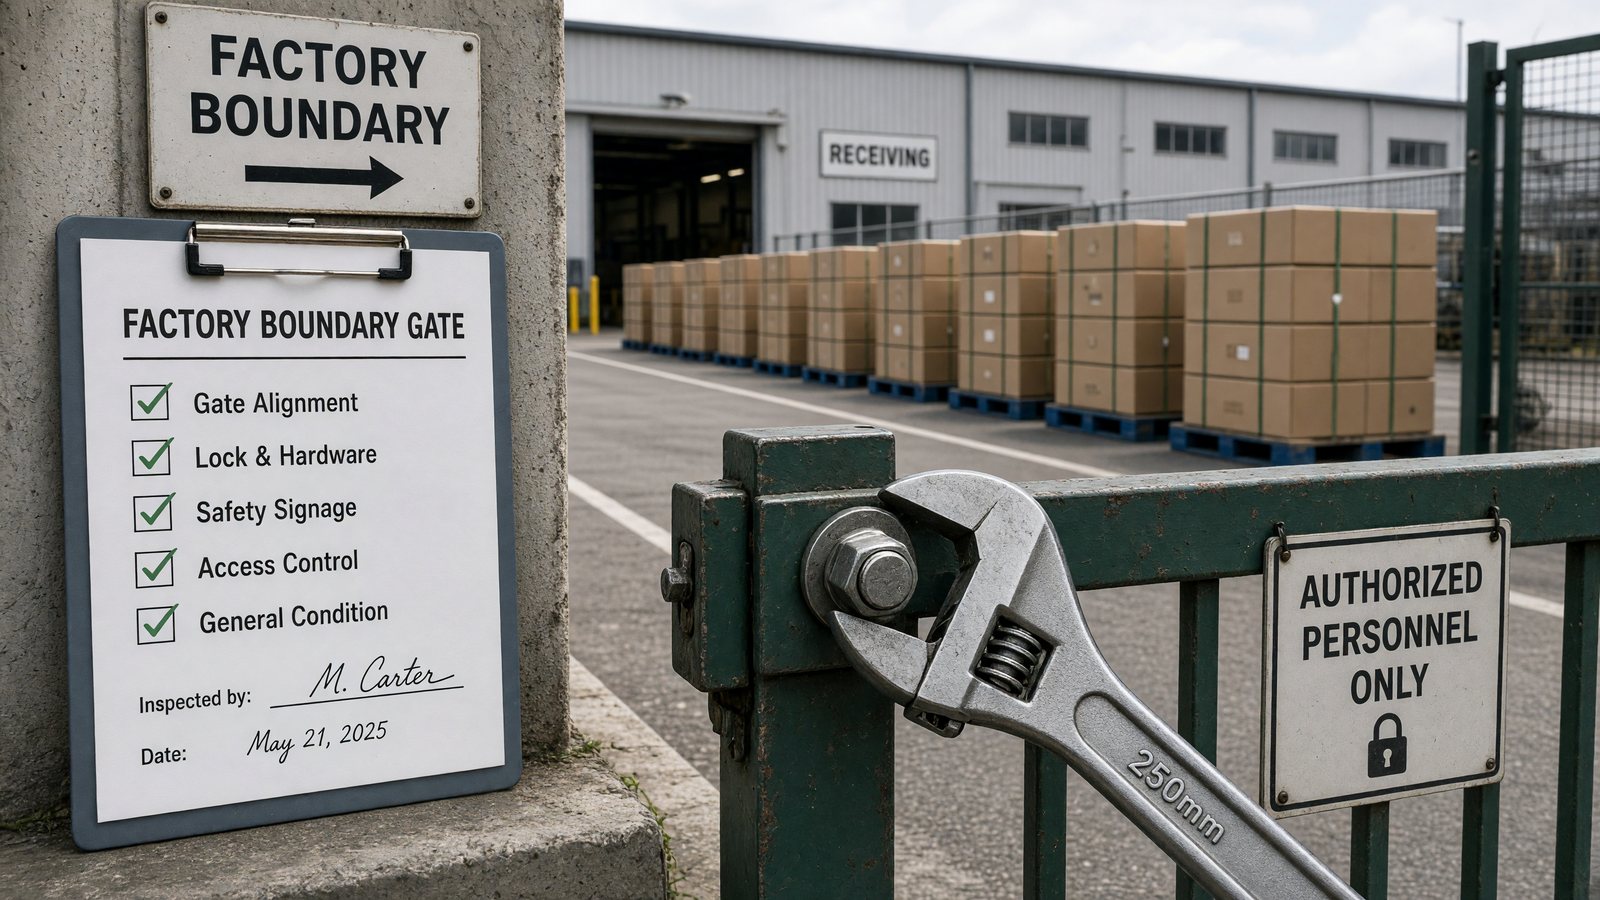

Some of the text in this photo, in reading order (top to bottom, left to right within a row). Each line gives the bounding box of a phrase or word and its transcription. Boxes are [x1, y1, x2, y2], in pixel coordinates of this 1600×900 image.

[210, 33, 427, 89] FACTORY
[190, 91, 450, 146] BOUNDARY
[829, 143, 930, 168] RECEIVING
[123, 308, 465, 340] FACTORY BOUNDARY GATE
[193, 391, 359, 419] Gate Alignment
[195, 444, 377, 469] Lock & Hardware
[196, 498, 357, 527] Safety Signage
[197, 549, 358, 579] Access Control
[1299, 560, 1483, 609] AUTHORIZED
[199, 601, 388, 634] General Condition
[1302, 610, 1478, 661] PERSONNEL
[308, 655, 455, 698] M. Carter
[1350, 662, 1430, 705] ONLY
[139, 688, 251, 716] Inspected by:
[141, 747, 187, 766] Date:
[246, 720, 389, 765] May 21, 2025
[1127, 749, 1226, 845] 250mm
